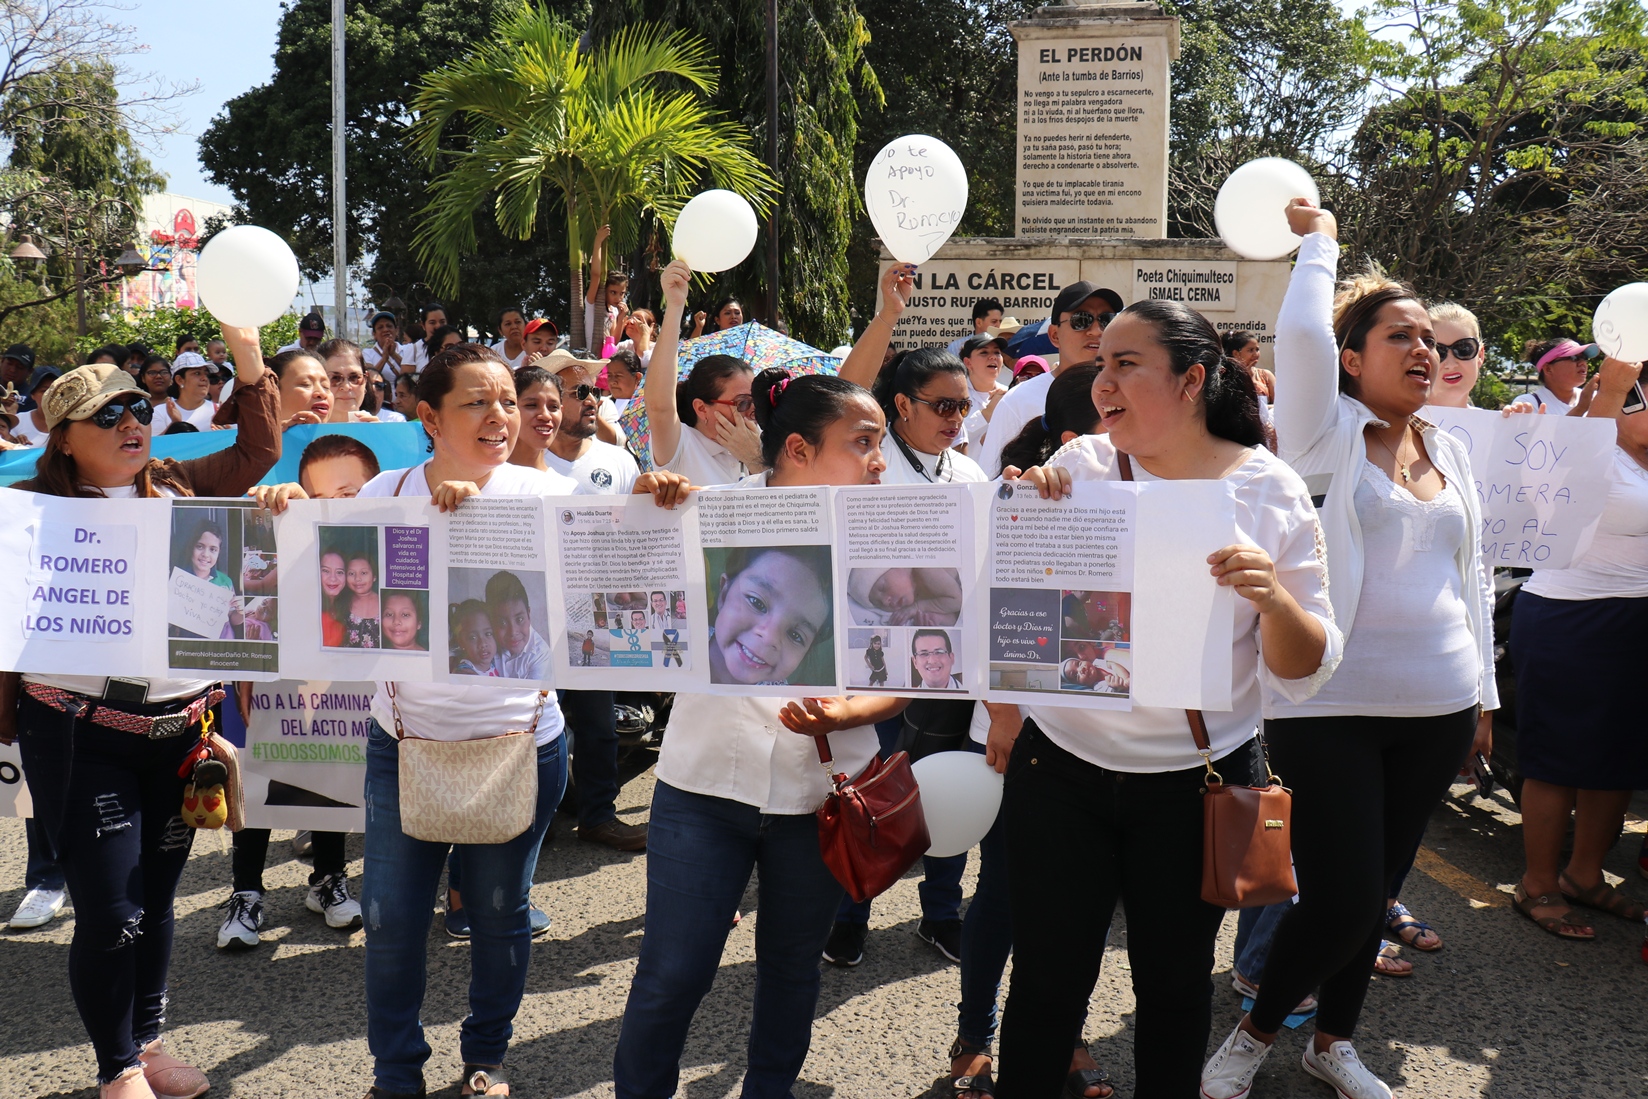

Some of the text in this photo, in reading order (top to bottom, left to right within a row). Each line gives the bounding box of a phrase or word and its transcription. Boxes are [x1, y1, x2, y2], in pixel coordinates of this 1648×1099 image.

[1040, 43, 1142, 64] EL PERDÓN
[1039, 69, 1144, 84] (Ante la tumba de Barrios)
[1035, 91, 1055, 99] vengo
[1070, 89, 1099, 98] sepulcro
[1106, 88, 1154, 97] escarnecerte,
[1034, 99, 1050, 108] llega
[1061, 99, 1086, 108] palabra
[1088, 98, 1123, 108] vengadora
[1043, 134, 1067, 143] puedes
[1068, 134, 1084, 142] herir
[1094, 134, 1132, 142] defenderte,
[1022, 162, 1050, 170] derecho
[1064, 180, 1101, 189] implacable
[888, 190, 915, 208] Dr.
[1053, 218, 1066, 226] que
[1077, 216, 1105, 224] instante
[1125, 216, 1158, 224] abandono
[1021, 226, 1047, 235] quisiste
[1048, 226, 1090, 235] engrandecer
[1099, 226, 1120, 235] patria
[931, 273, 960, 290] LA
[967, 269, 1060, 291] CÁRCEL
[1137, 269, 1234, 286] Poeta Chiquimulteco
[905, 296, 947, 308] JUSTO
[1004, 297, 1054, 308] BARRIO
[1149, 287, 1221, 302] ISMAEL CERNA
[948, 318, 965, 326] que
[1217, 321, 1266, 330] encendida
[910, 328, 937, 338] puedo
[1505, 432, 1568, 474] SOY
[1522, 518, 1557, 536] AL
[74, 528, 102, 544] Dr.
[40, 554, 128, 575] ROMERO
[32, 585, 130, 605] ANGEL DE
[26, 614, 132, 636] LOS NIÑOS
[993, 622, 1016, 630] doctor
[1023, 622, 1042, 631] Dios
[251, 693, 374, 711] NO A LA CRIMINA
[281, 719, 307, 736] DEL
[311, 719, 347, 737] ACTO
